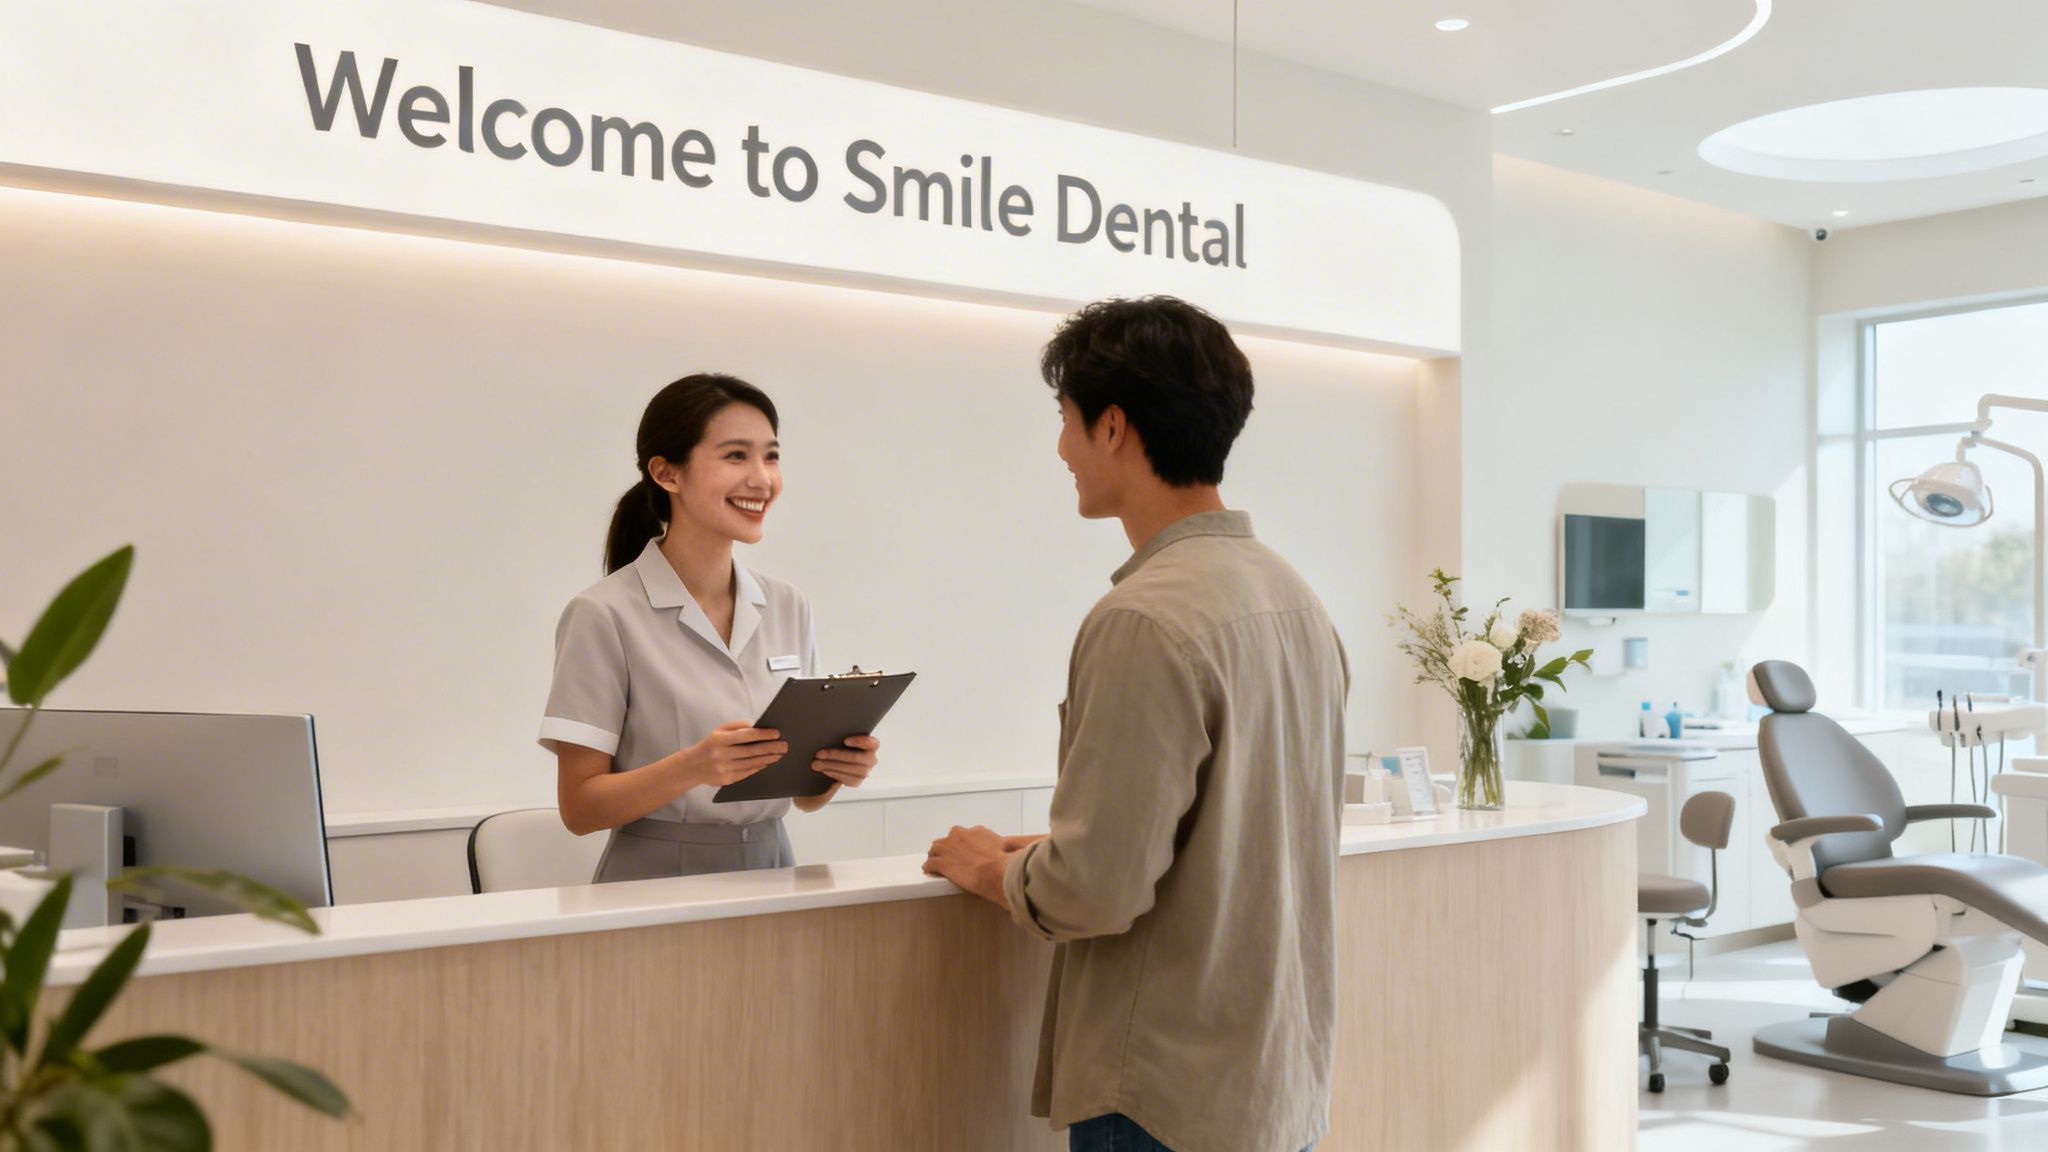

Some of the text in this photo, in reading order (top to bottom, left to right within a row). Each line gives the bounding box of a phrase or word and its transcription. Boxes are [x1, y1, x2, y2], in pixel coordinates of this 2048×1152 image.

[294, 42, 1247, 269] Welcome to Smile Dental
